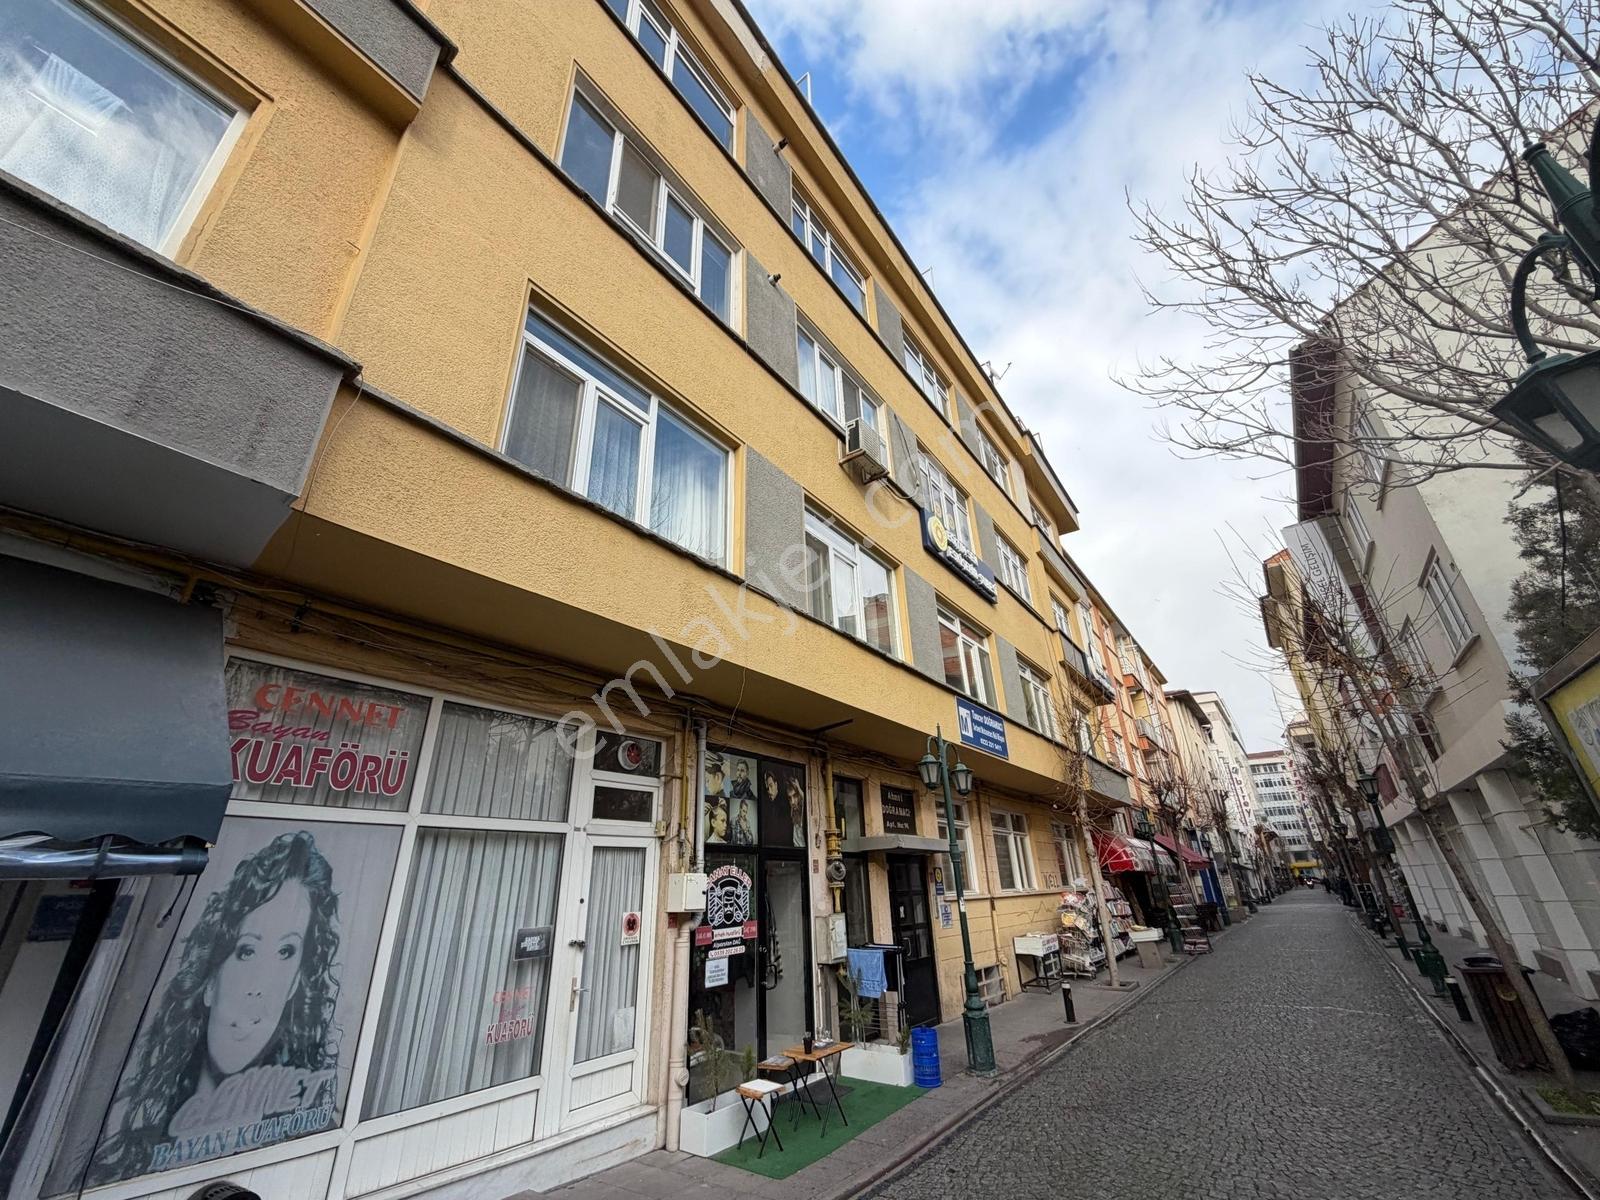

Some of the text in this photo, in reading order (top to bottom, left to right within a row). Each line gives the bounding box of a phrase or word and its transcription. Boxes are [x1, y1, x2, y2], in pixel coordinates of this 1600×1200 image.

[228, 709, 330, 741] Bayan
[255, 683, 405, 729] CENNET
[485, 1011, 535, 1045] KUAFÖRÜ
[148, 1101, 335, 1171] BAYAN KUAFÖRÜ
